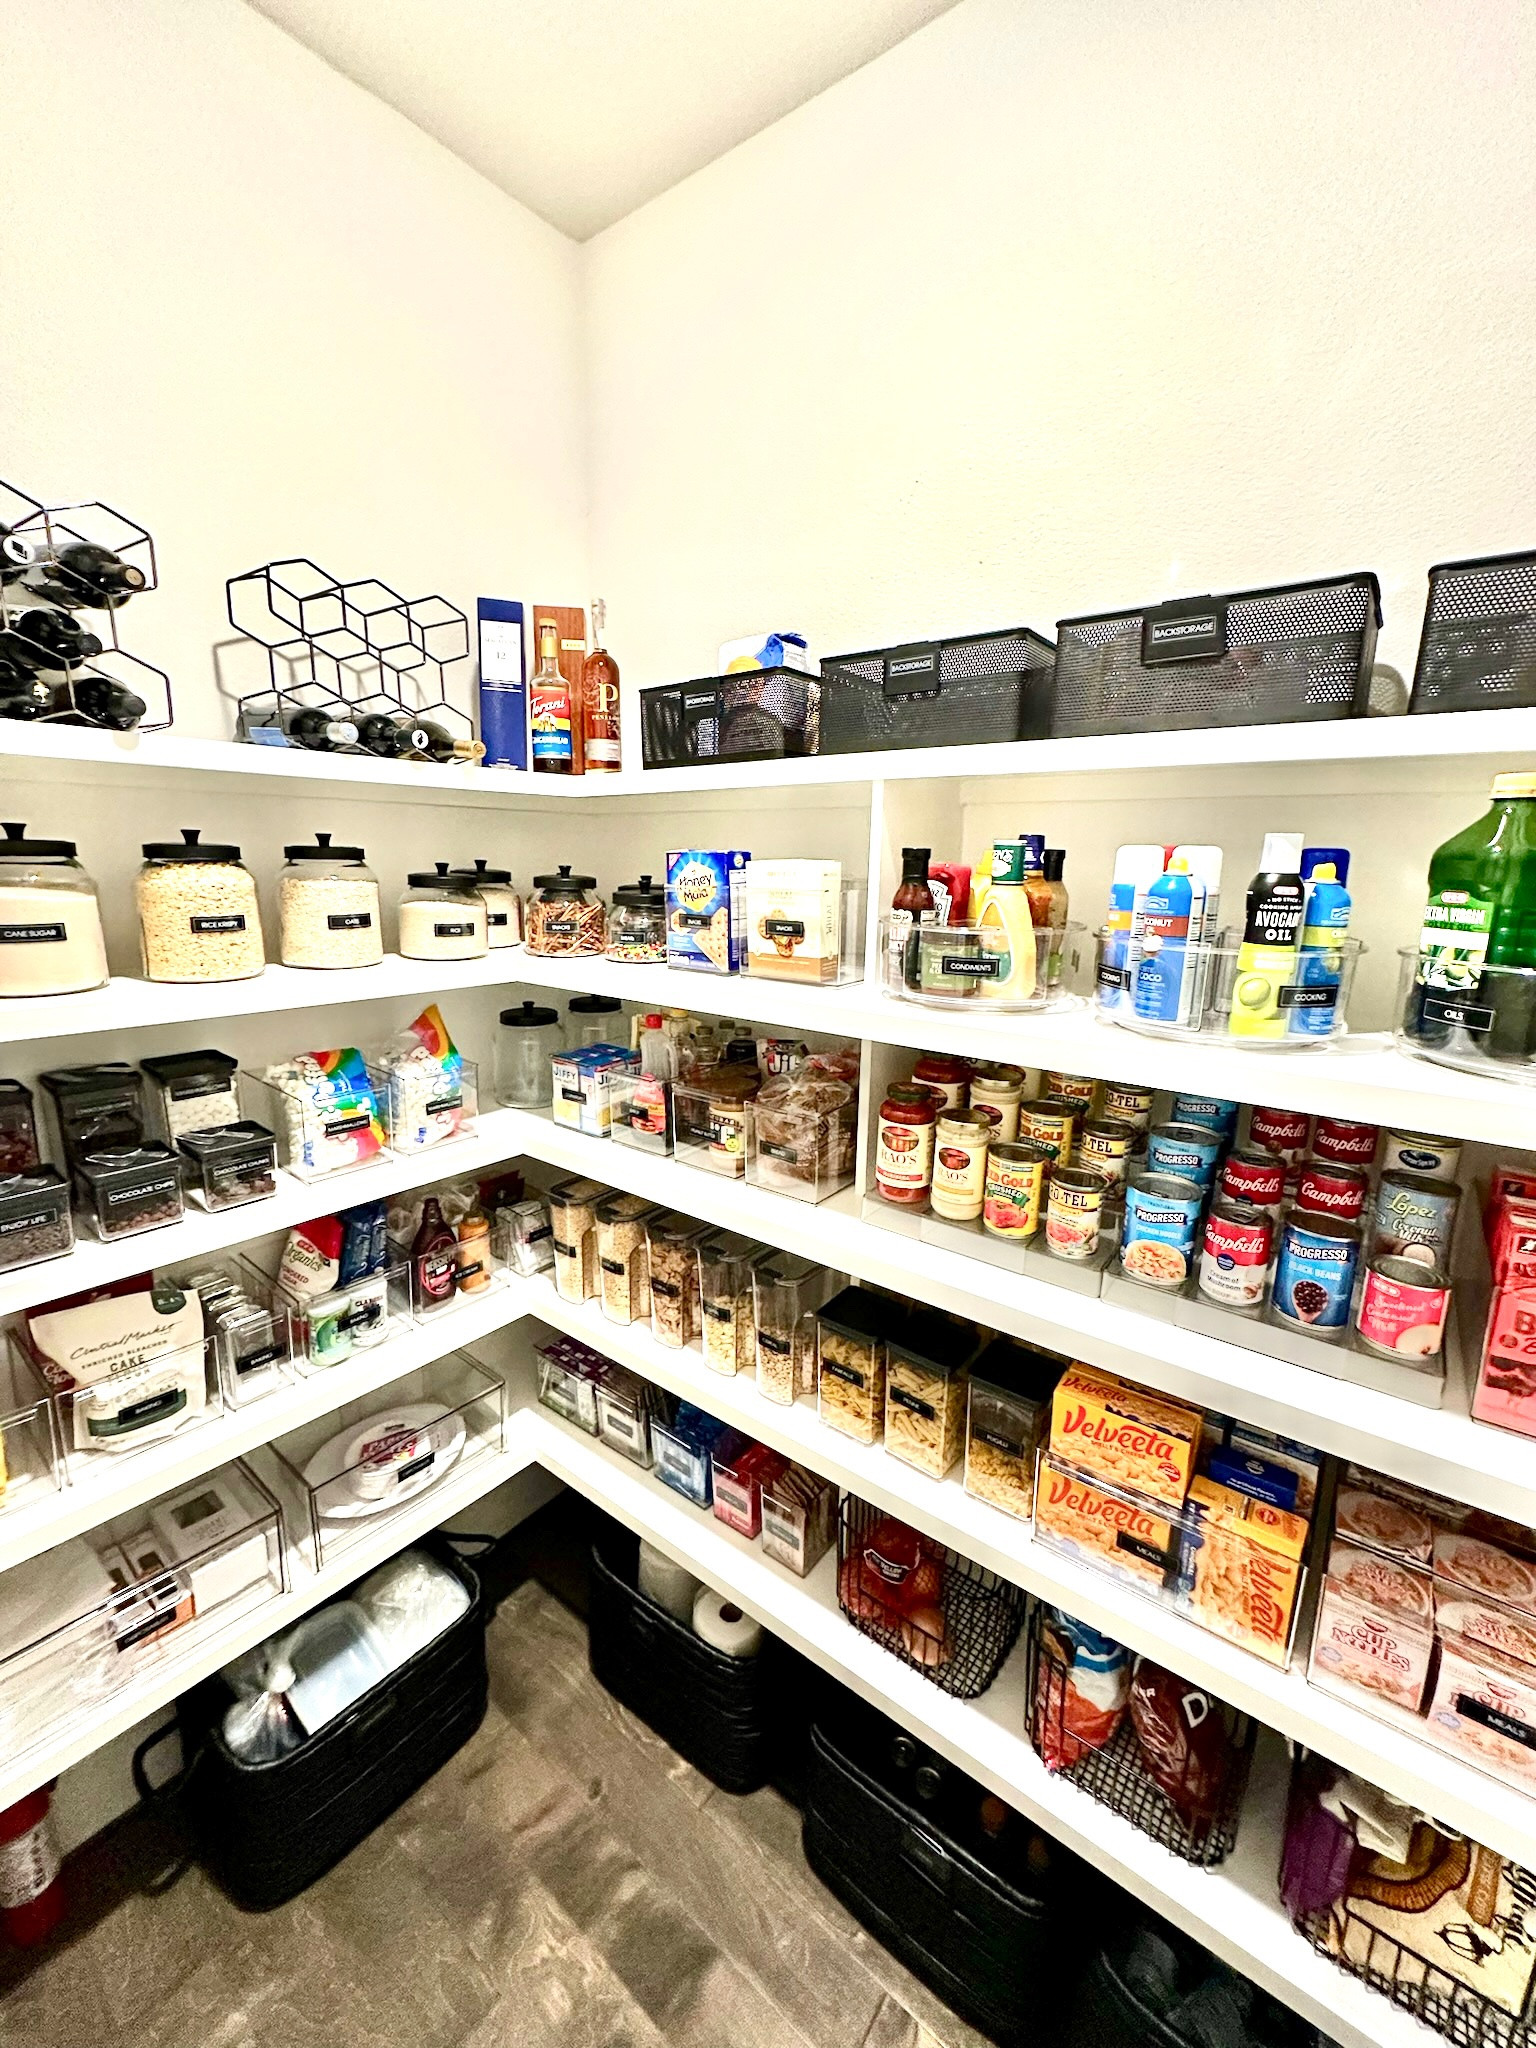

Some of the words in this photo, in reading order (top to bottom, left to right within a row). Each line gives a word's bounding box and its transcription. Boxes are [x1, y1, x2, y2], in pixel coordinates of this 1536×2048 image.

[1154, 620, 1214, 640] BACKSTORAGE
[530, 696, 566, 716] Torani
[679, 873, 712, 888] Honey
[683, 887, 709, 903] Maid
[1255, 911, 1301, 928] AVOCAD
[3, 930, 28, 938] CANE
[27, 929, 57, 938] SUGAR
[1264, 928, 1292, 941] OIL
[1294, 992, 1327, 1002] COOKING
[1443, 1009, 1465, 1021] OILS
[553, 1065, 577, 1081] JIFFY
[1064, 1084, 1093, 1097] GOLD
[1176, 1101, 1217, 1114] PROGRESSO
[1032, 1127, 1064, 1142] GOLD
[1252, 1116, 1306, 1138] Campbell's
[880, 1149, 917, 1165] RAO'S
[1154, 1152, 1199, 1165] PROGRESSO
[1001, 1174, 1034, 1188] GOLD
[1222, 1167, 1280, 1193] Campbell's
[110, 1184, 154, 1202] CHOCOLATE
[0, 1218, 28, 1234] ENJOY
[30, 1215, 48, 1226] LIFE
[1136, 1209, 1185, 1223] PROGRESSO
[1205, 1222, 1264, 1254] Campbell's
[287, 1242, 324, 1272] Organics
[1288, 1244, 1348, 1263] PROGRESSO
[109, 1353, 147, 1374] CAKE
[1062, 1376, 1128, 1403] Velveeta
[1062, 1405, 1176, 1461] Velveeta
[1048, 1478, 1155, 1537] Velveeta
[1136, 1545, 1162, 1562] MEALS
[1351, 1624, 1397, 1651] CUP
[1331, 1627, 1411, 1672] NOODLES
[1487, 1714, 1527, 1739] MEALS
